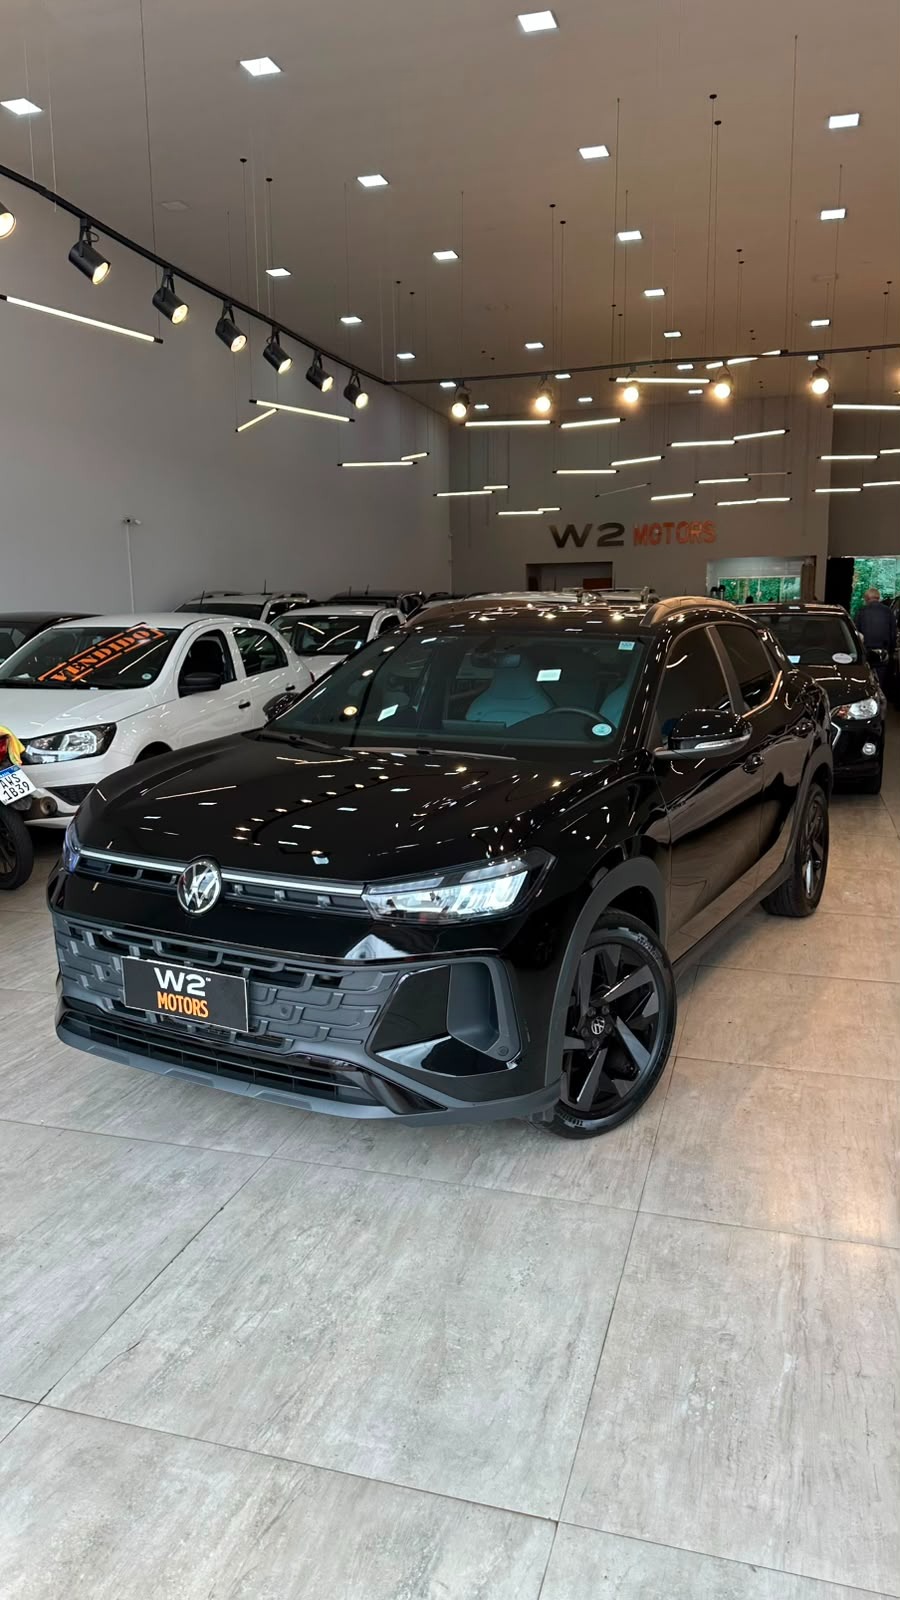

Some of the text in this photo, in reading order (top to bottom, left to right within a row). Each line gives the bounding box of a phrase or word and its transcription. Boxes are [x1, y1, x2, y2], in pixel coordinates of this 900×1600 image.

[549, 520, 717, 548] W2 MOTORS
[50, 630, 151, 682] VENDIDO
[3, 781, 30, 800] 1B39
[157, 990, 209, 1018] MOTORS
